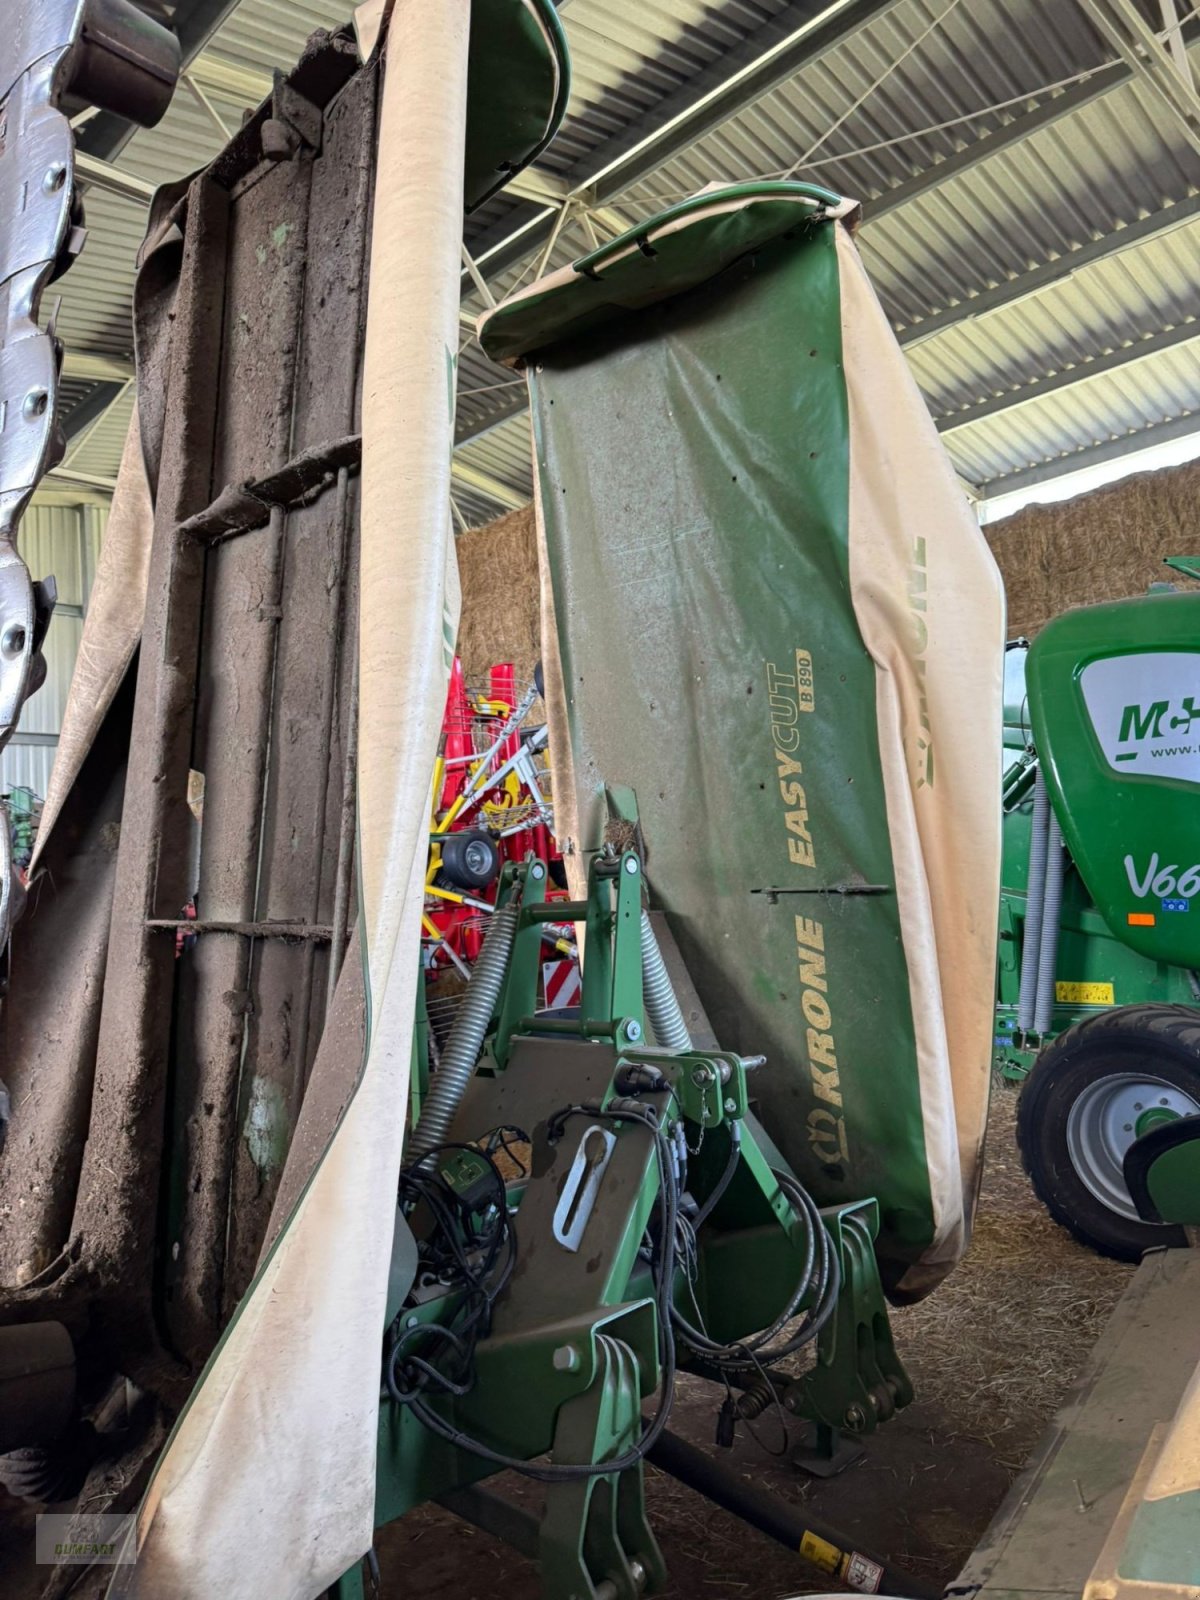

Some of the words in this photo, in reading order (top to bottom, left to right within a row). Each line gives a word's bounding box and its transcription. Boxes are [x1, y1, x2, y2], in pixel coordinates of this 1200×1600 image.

[799, 657, 812, 688] 890
[800, 693, 813, 703] B
[766, 663, 816, 868] EASYCUT
[1151, 745, 1200, 758] www.
[795, 914, 843, 1108] KRONE
